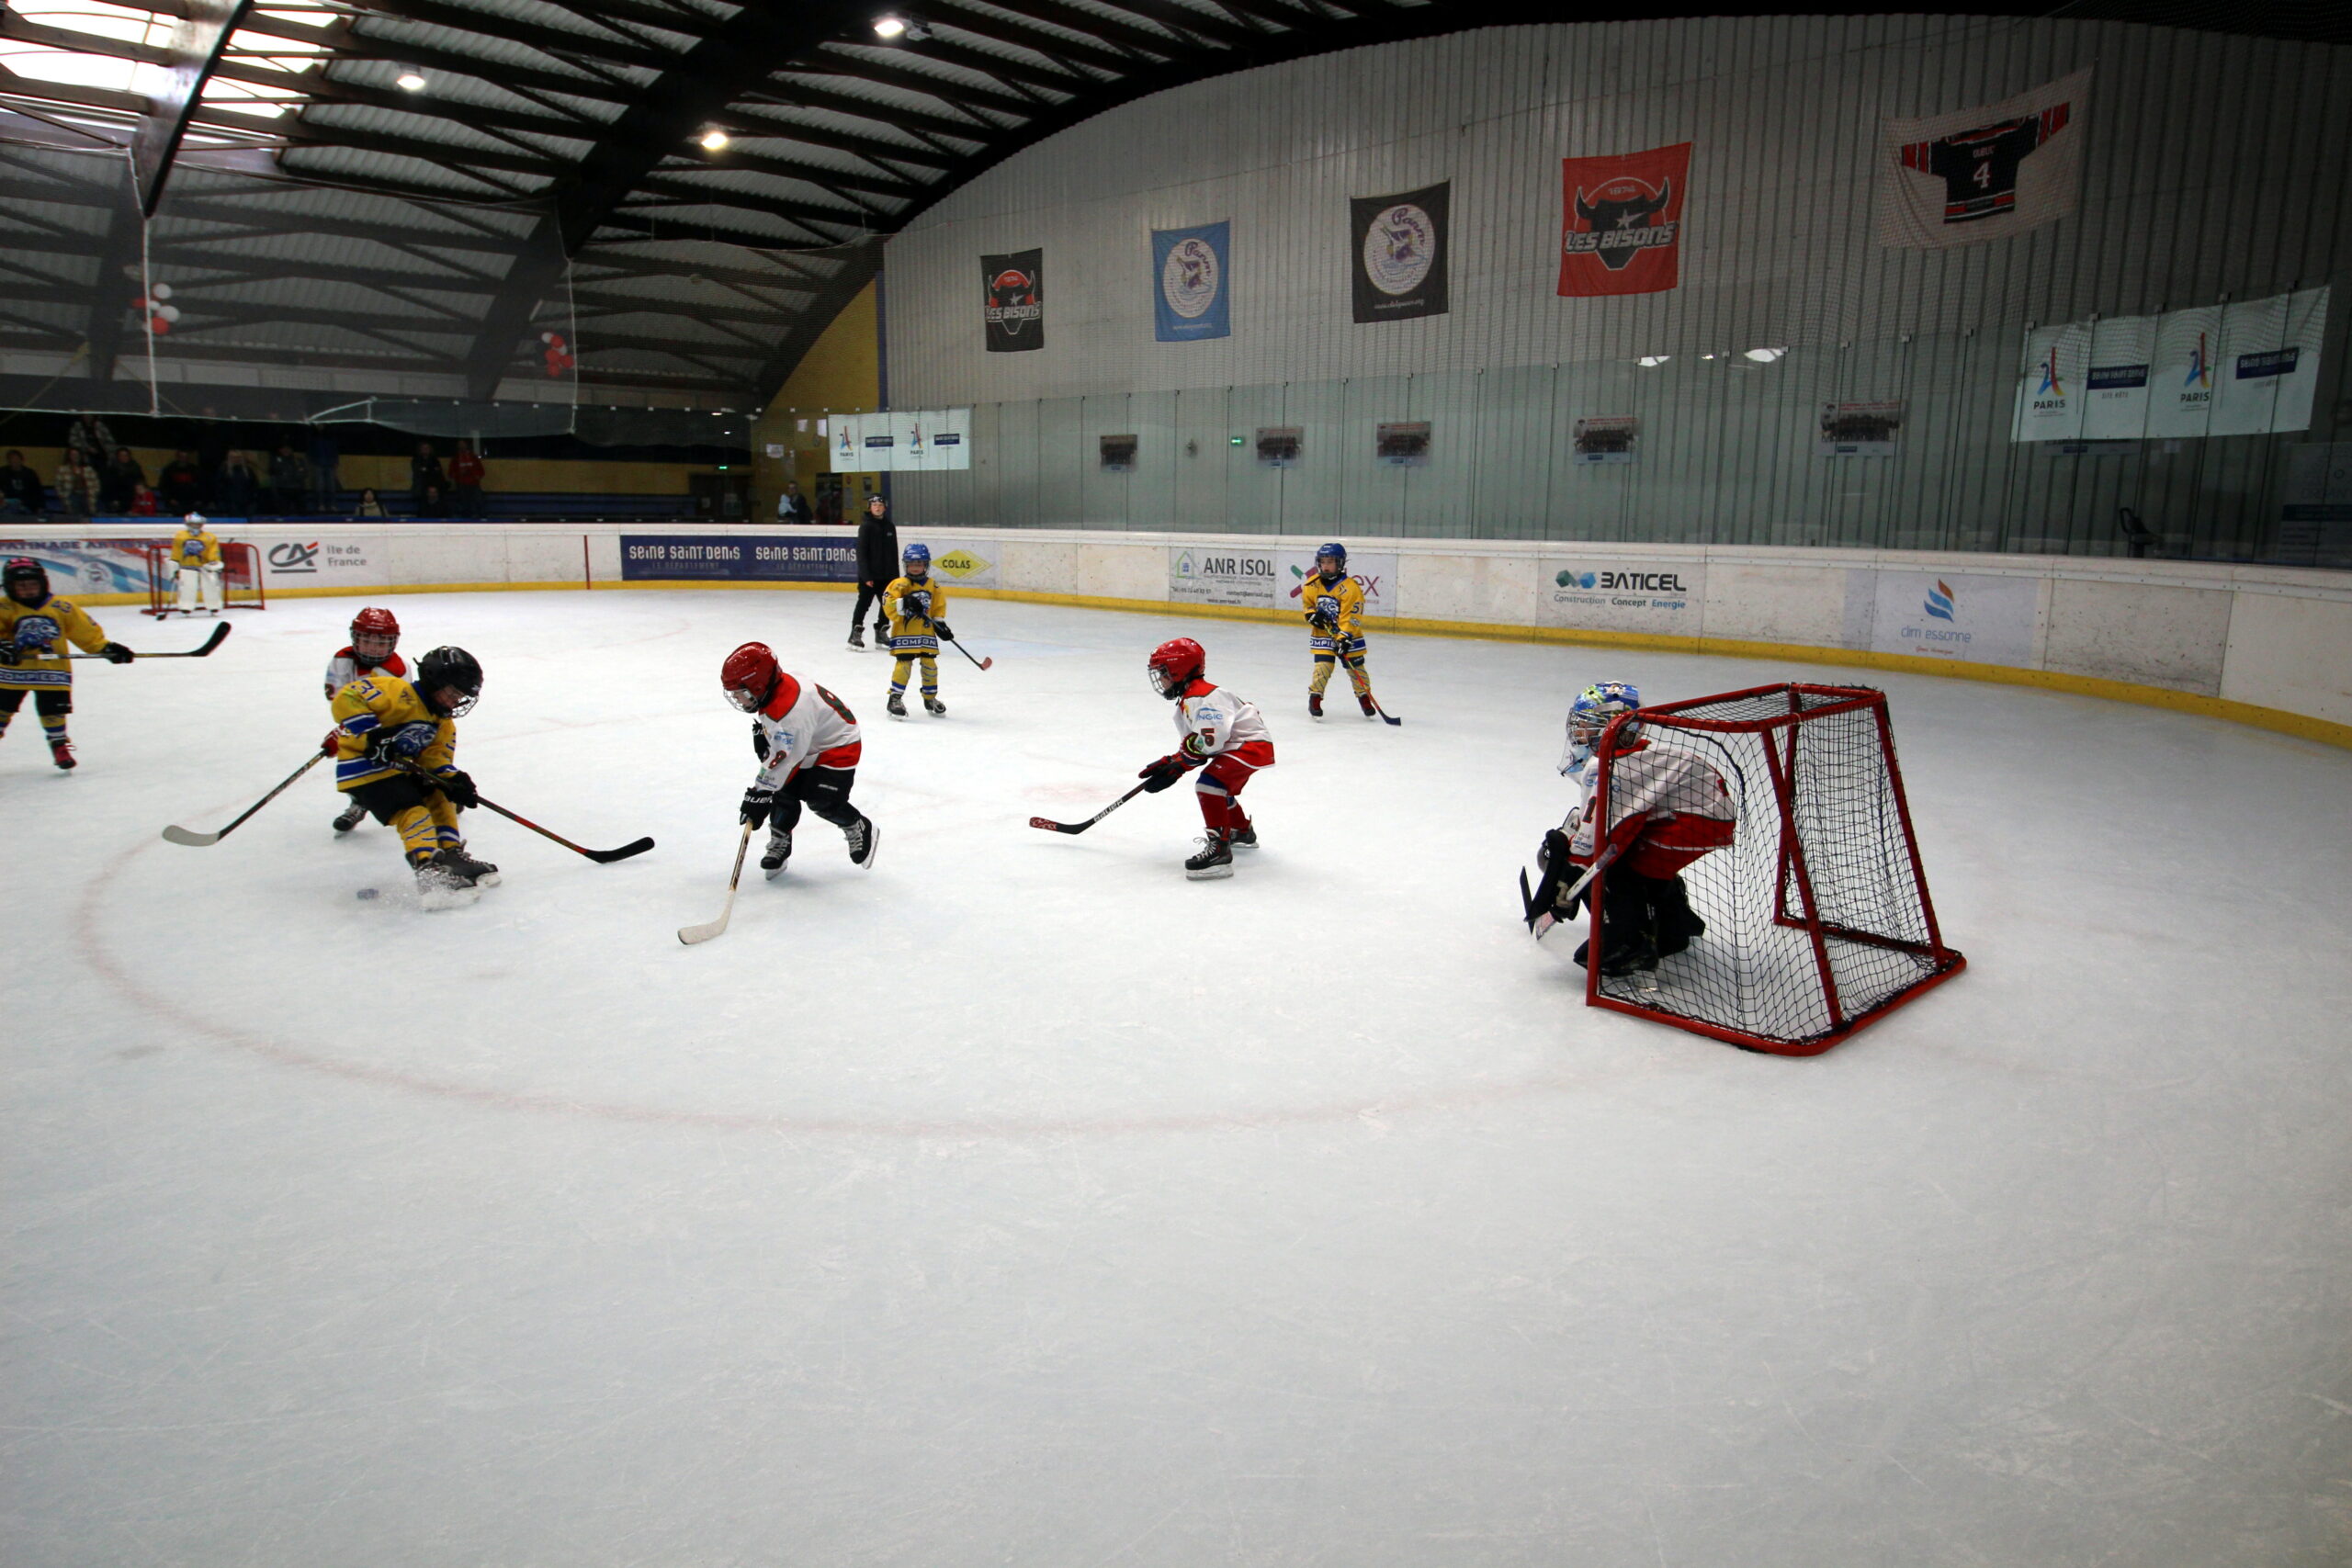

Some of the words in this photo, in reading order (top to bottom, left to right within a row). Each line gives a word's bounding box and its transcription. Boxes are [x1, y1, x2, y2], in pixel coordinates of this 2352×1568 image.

[1973, 162, 1990, 188] 4
[1566, 231, 1600, 251] LES
[1600, 221, 1677, 249] BISONS
[986, 307, 1002, 321] LES
[1002, 301, 1042, 319] BISONS
[2033, 400, 2065, 410] PARIS
[2180, 392, 2210, 402] PARIS
[345, 545, 360, 554] de
[328, 557, 368, 566] France
[942, 558, 971, 569] COLAS
[1204, 557, 1237, 575] ANR
[1240, 558, 1275, 577] ISOL
[1600, 571, 1687, 592] BATICEL
[1554, 593, 1606, 605] Construction
[1611, 597, 1646, 608] Concept
[1651, 599, 1686, 611] Energie
[1925, 629, 1972, 643] essonne
[1201, 728, 1215, 747] 5
[1582, 795, 1597, 824] 1
